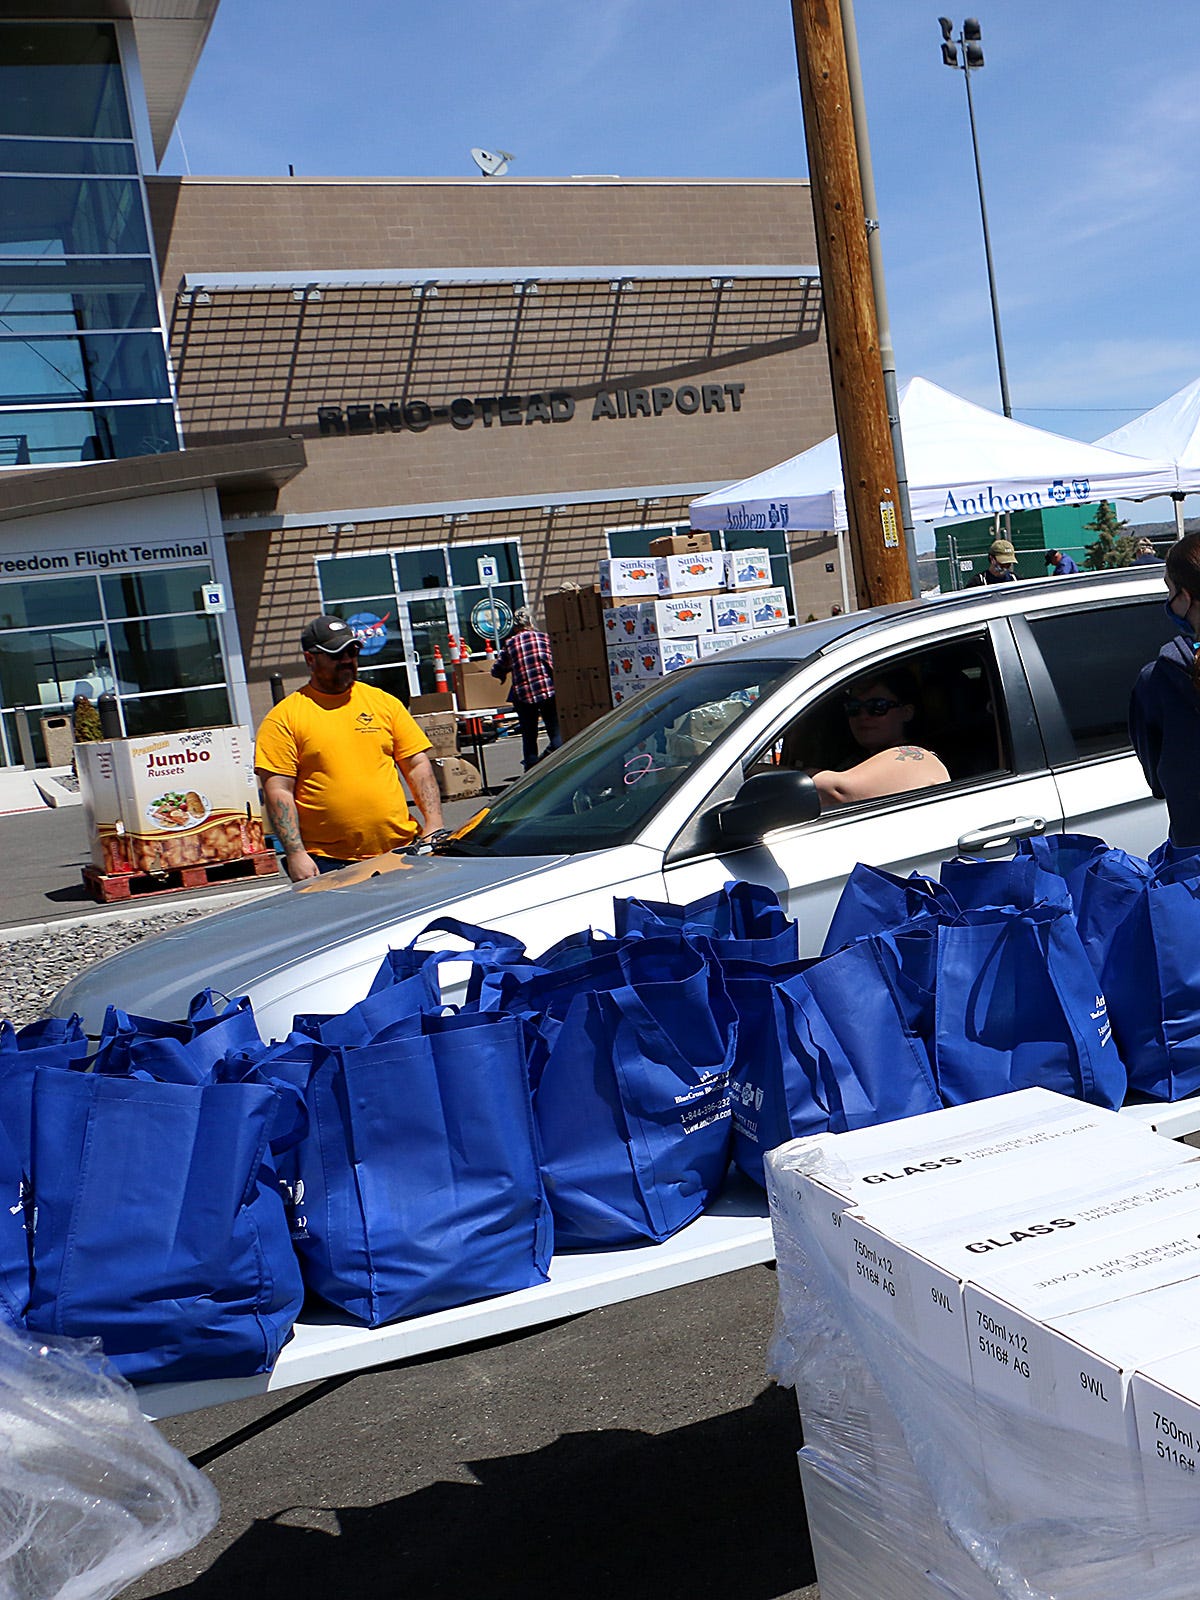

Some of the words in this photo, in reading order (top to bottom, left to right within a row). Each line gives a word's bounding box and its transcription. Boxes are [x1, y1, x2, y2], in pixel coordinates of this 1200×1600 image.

[317, 391, 576, 436] RENO-STEAD
[592, 383, 746, 421] AIRPORT
[943, 484, 1042, 518] Anthem
[726, 504, 767, 530] Anthem
[0, 555, 69, 573] reedom
[74, 549, 129, 568] Flight
[130, 541, 209, 562] Terminal
[619, 560, 656, 571] Sunkist
[678, 554, 714, 567] Sunkist
[665, 600, 703, 613] Sunkist
[132, 739, 170, 758] Premium
[146, 748, 211, 769] Jumbo
[147, 767, 186, 778] Russets
[624, 753, 666, 785] 2
[862, 1155, 963, 1185] GLASS
[1075, 1204, 1109, 1218] THIS
[1110, 1193, 1148, 1208] SIDE
[1147, 1186, 1168, 1198] UP
[1083, 1200, 1146, 1222] HANDLE
[1144, 1187, 1184, 1203] WITH
[965, 1217, 1077, 1255] GLASS
[1124, 1237, 1190, 1262] HANDLE
[1163, 1243, 1200, 1259] THIS
[853, 1238, 877, 1261] 750ml
[877, 1256, 893, 1275] x12
[1084, 1257, 1124, 1275] WITH
[1128, 1255, 1163, 1271] SIDE
[856, 1261, 880, 1286] 5116#
[882, 1277, 896, 1297] AG
[1032, 1271, 1081, 1291] CARE
[1100, 1266, 1124, 1279] UP
[931, 1287, 953, 1313] 9WL
[976, 1310, 1007, 1341] 750ml
[1008, 1330, 1029, 1354] x12
[979, 1335, 1009, 1366] 5116#
[1013, 1356, 1030, 1379] AG
[1080, 1371, 1109, 1403] 9WL
[1152, 1410, 1194, 1450] 750ml
[1156, 1440, 1196, 1476] 5116#
